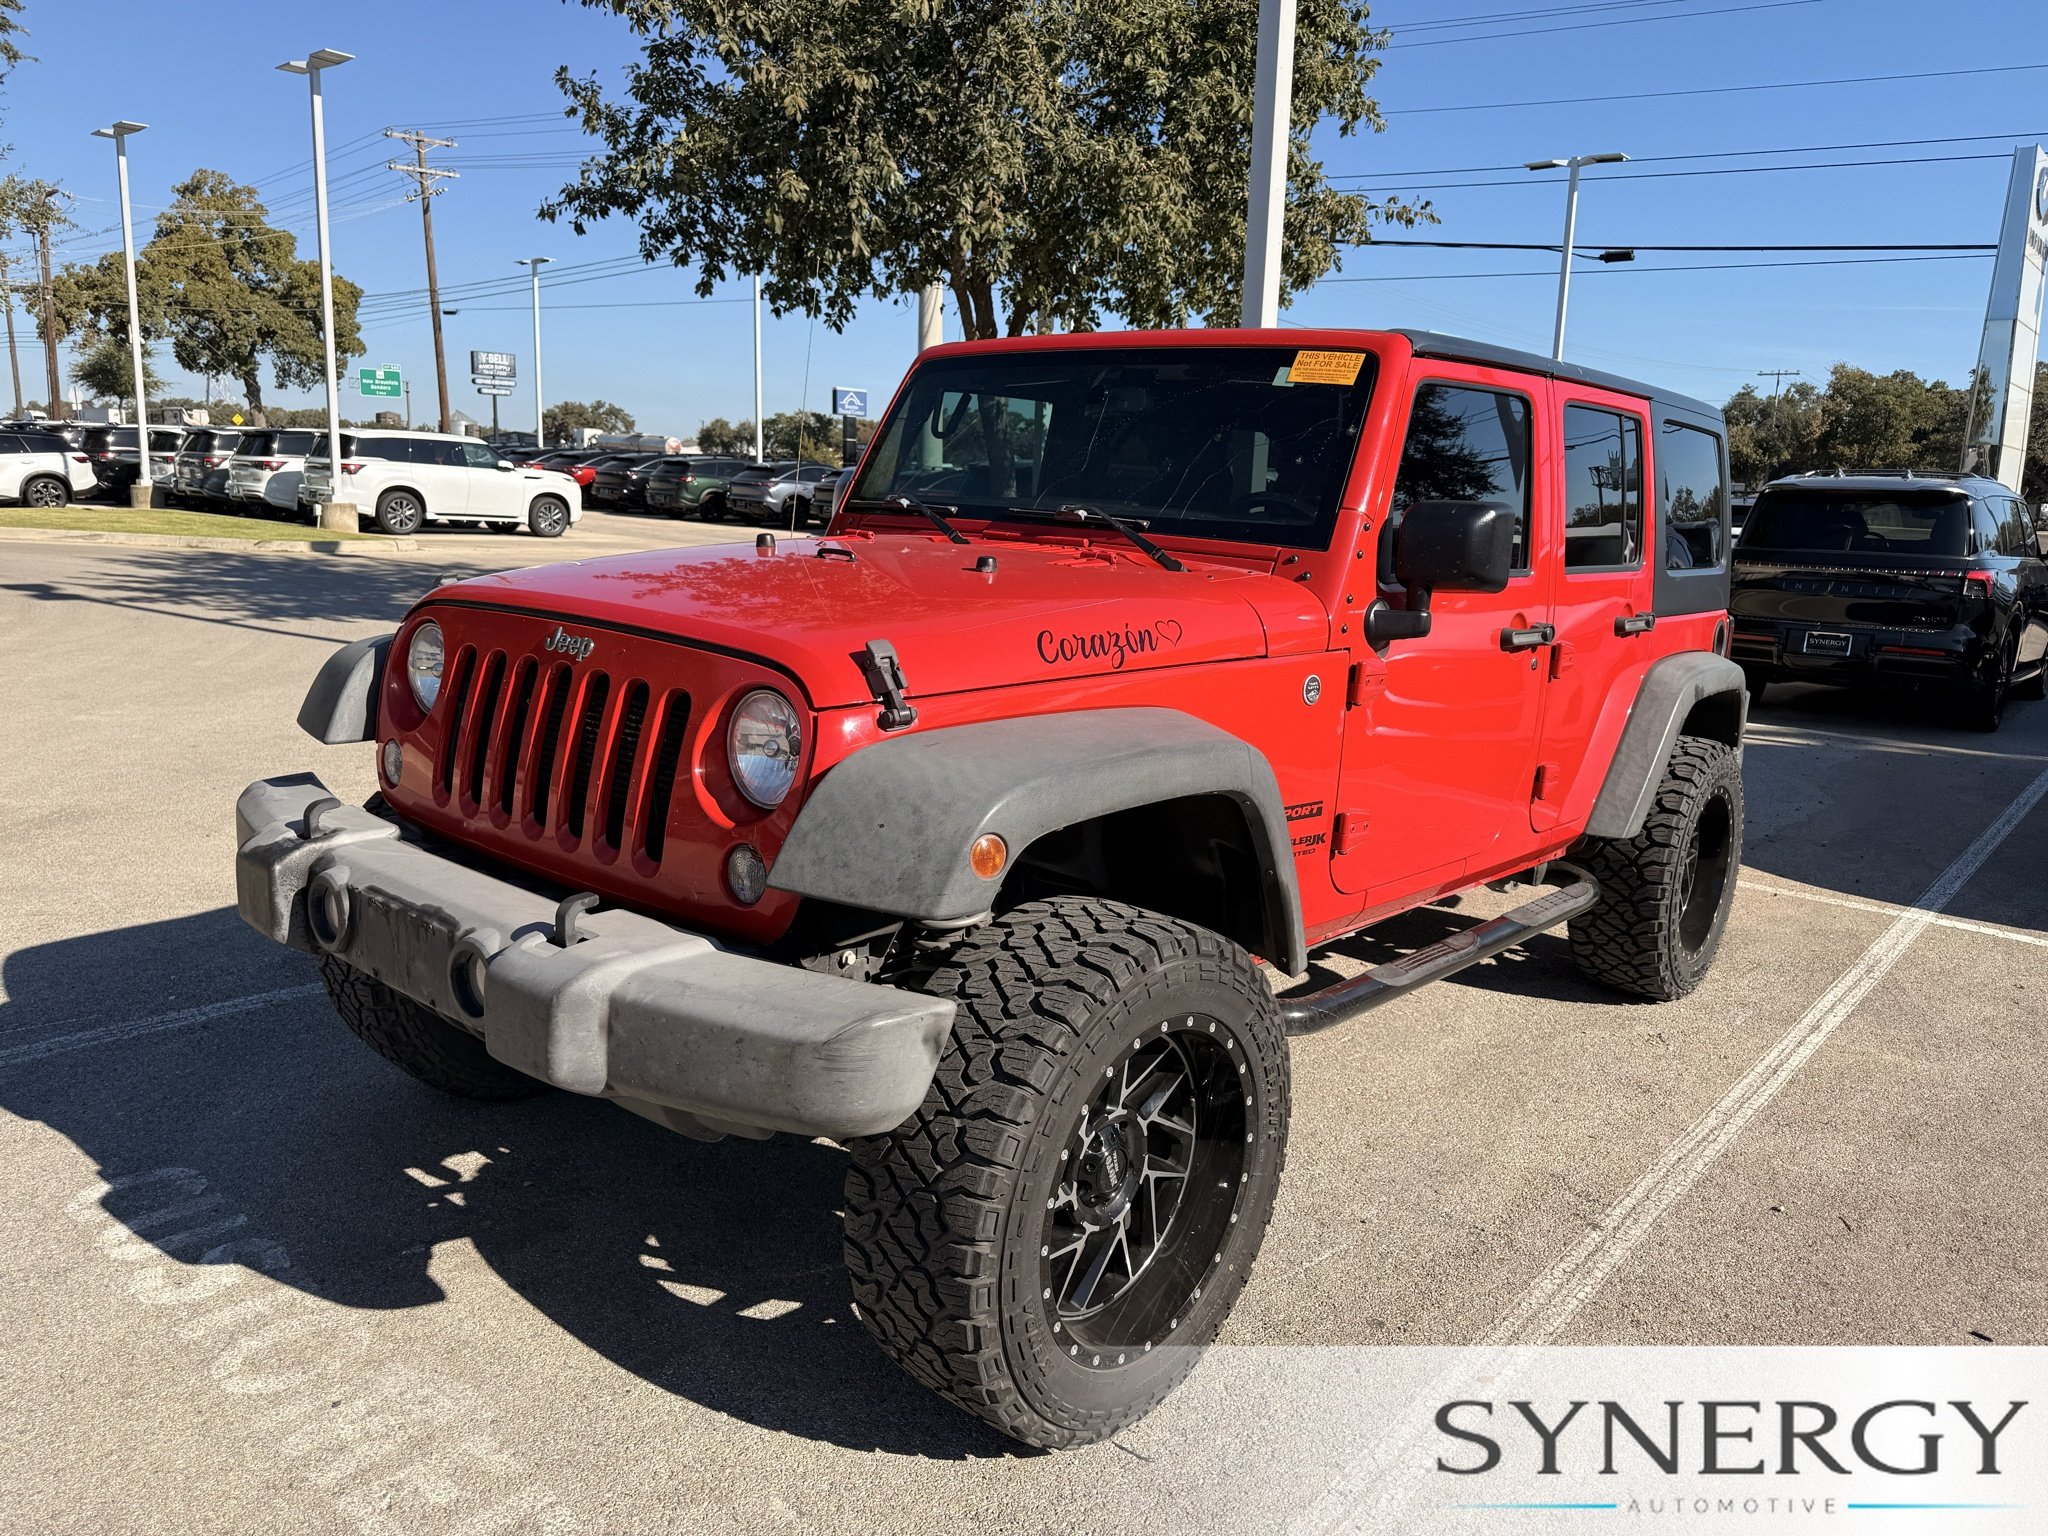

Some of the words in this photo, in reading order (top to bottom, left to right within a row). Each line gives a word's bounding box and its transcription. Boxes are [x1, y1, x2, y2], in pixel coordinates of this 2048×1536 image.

[1301, 352, 1320, 360] THIS
[1323, 353, 1362, 362] VEHICLE
[1782, 580, 1896, 596] INFINITI
[544, 624, 595, 662] Jeep
[1036, 622, 1159, 670] Corazón
[1809, 638, 1847, 647] SYNERGY
[1284, 804, 1323, 818] PORT
